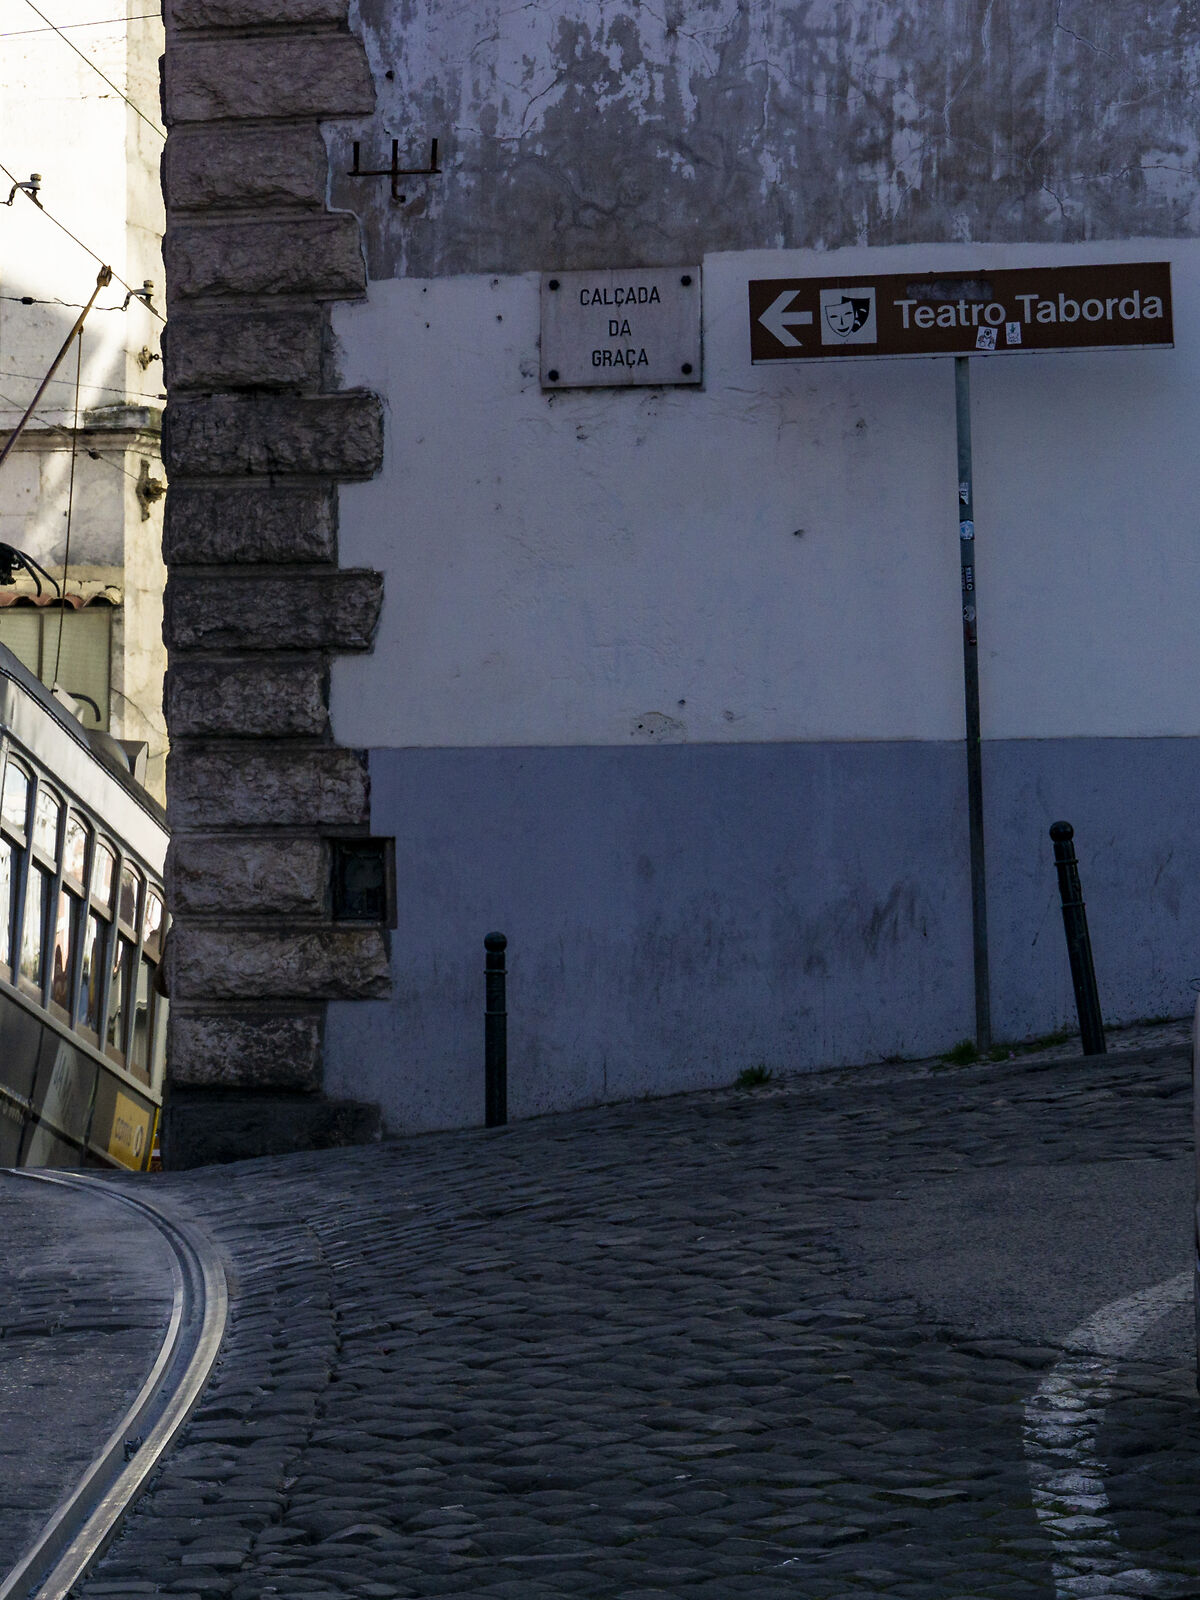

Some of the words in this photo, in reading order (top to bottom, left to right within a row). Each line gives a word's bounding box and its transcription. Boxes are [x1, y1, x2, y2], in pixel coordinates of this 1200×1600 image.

[580, 286, 661, 307] CALÇADA
[893, 298, 1006, 330] Teatro
[1015, 290, 1164, 325] Taborda
[608, 319, 632, 337] DA
[592, 348, 649, 369] GRAÇA
